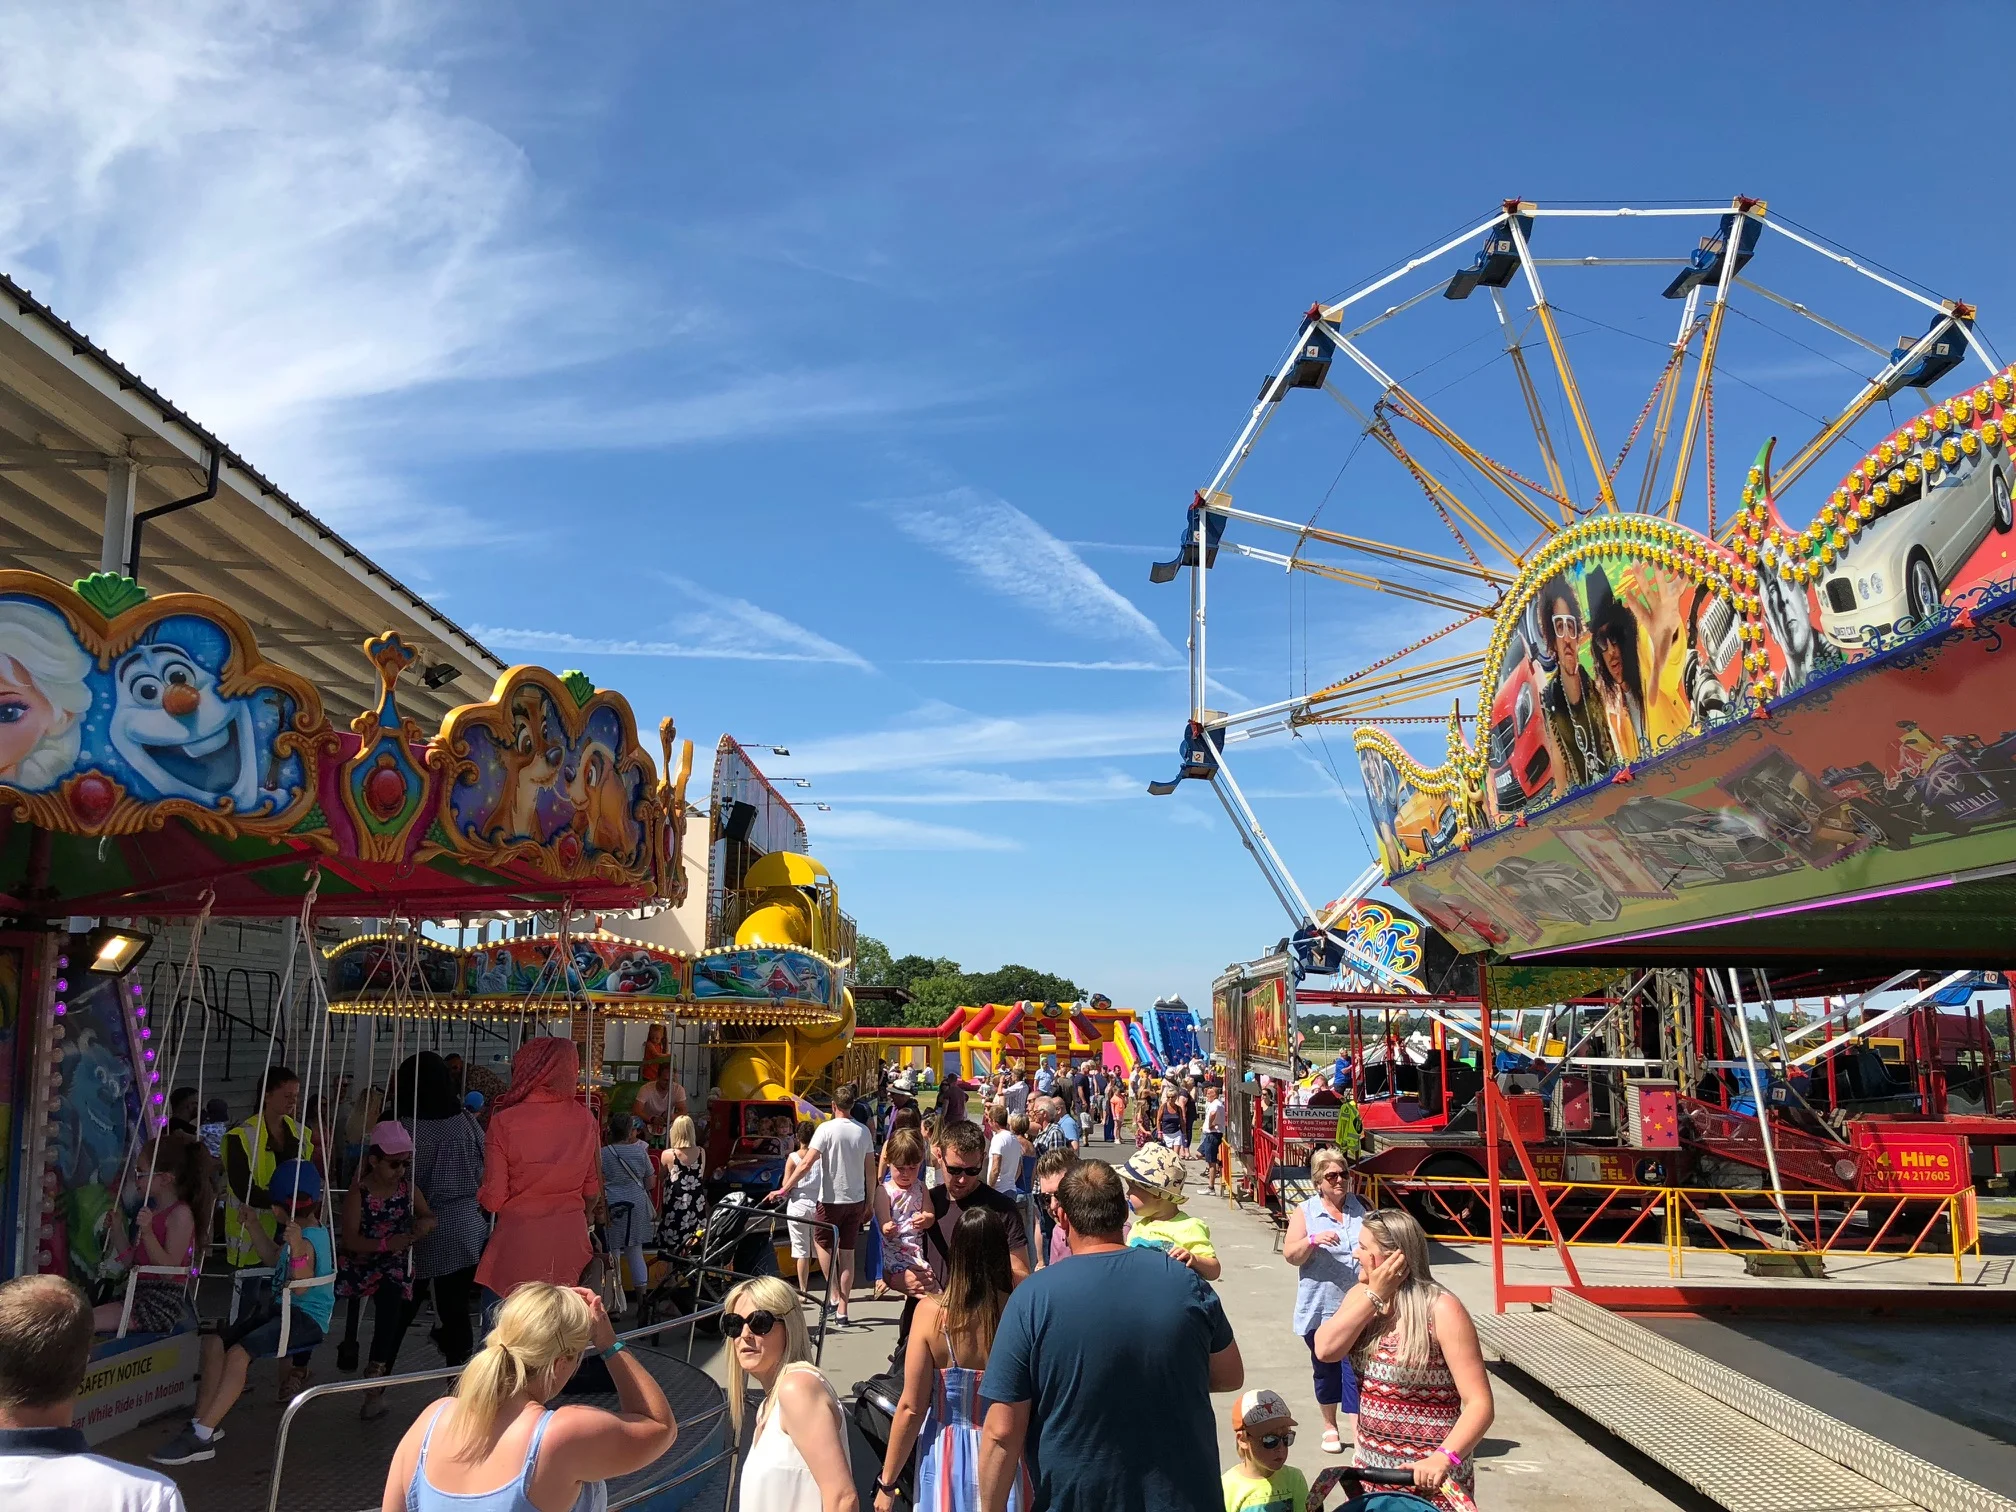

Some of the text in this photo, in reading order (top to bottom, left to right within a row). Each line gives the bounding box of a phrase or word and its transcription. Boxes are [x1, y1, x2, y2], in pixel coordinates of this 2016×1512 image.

[1500, 242, 1507, 251] 5
[1308, 348, 1316, 356] 4
[1939, 345, 1946, 354] 7
[1193, 753, 1202, 762] 2
[1945, 790, 1999, 813] INFINITI
[1985, 973, 1997, 982] 10
[1775, 1090, 1784, 1099] 11
[1286, 1109, 1338, 1118] ENTRANCE
[1877, 1151, 1949, 1167] 4 Hire
[1877, 1171, 1951, 1181] 07774 217605
[78, 1357, 152, 1395] SAFETY NOTICE
[88, 1404, 113, 1425] While
[115, 1397, 134, 1415] Ride
[154, 1380, 185, 1400] Motion
